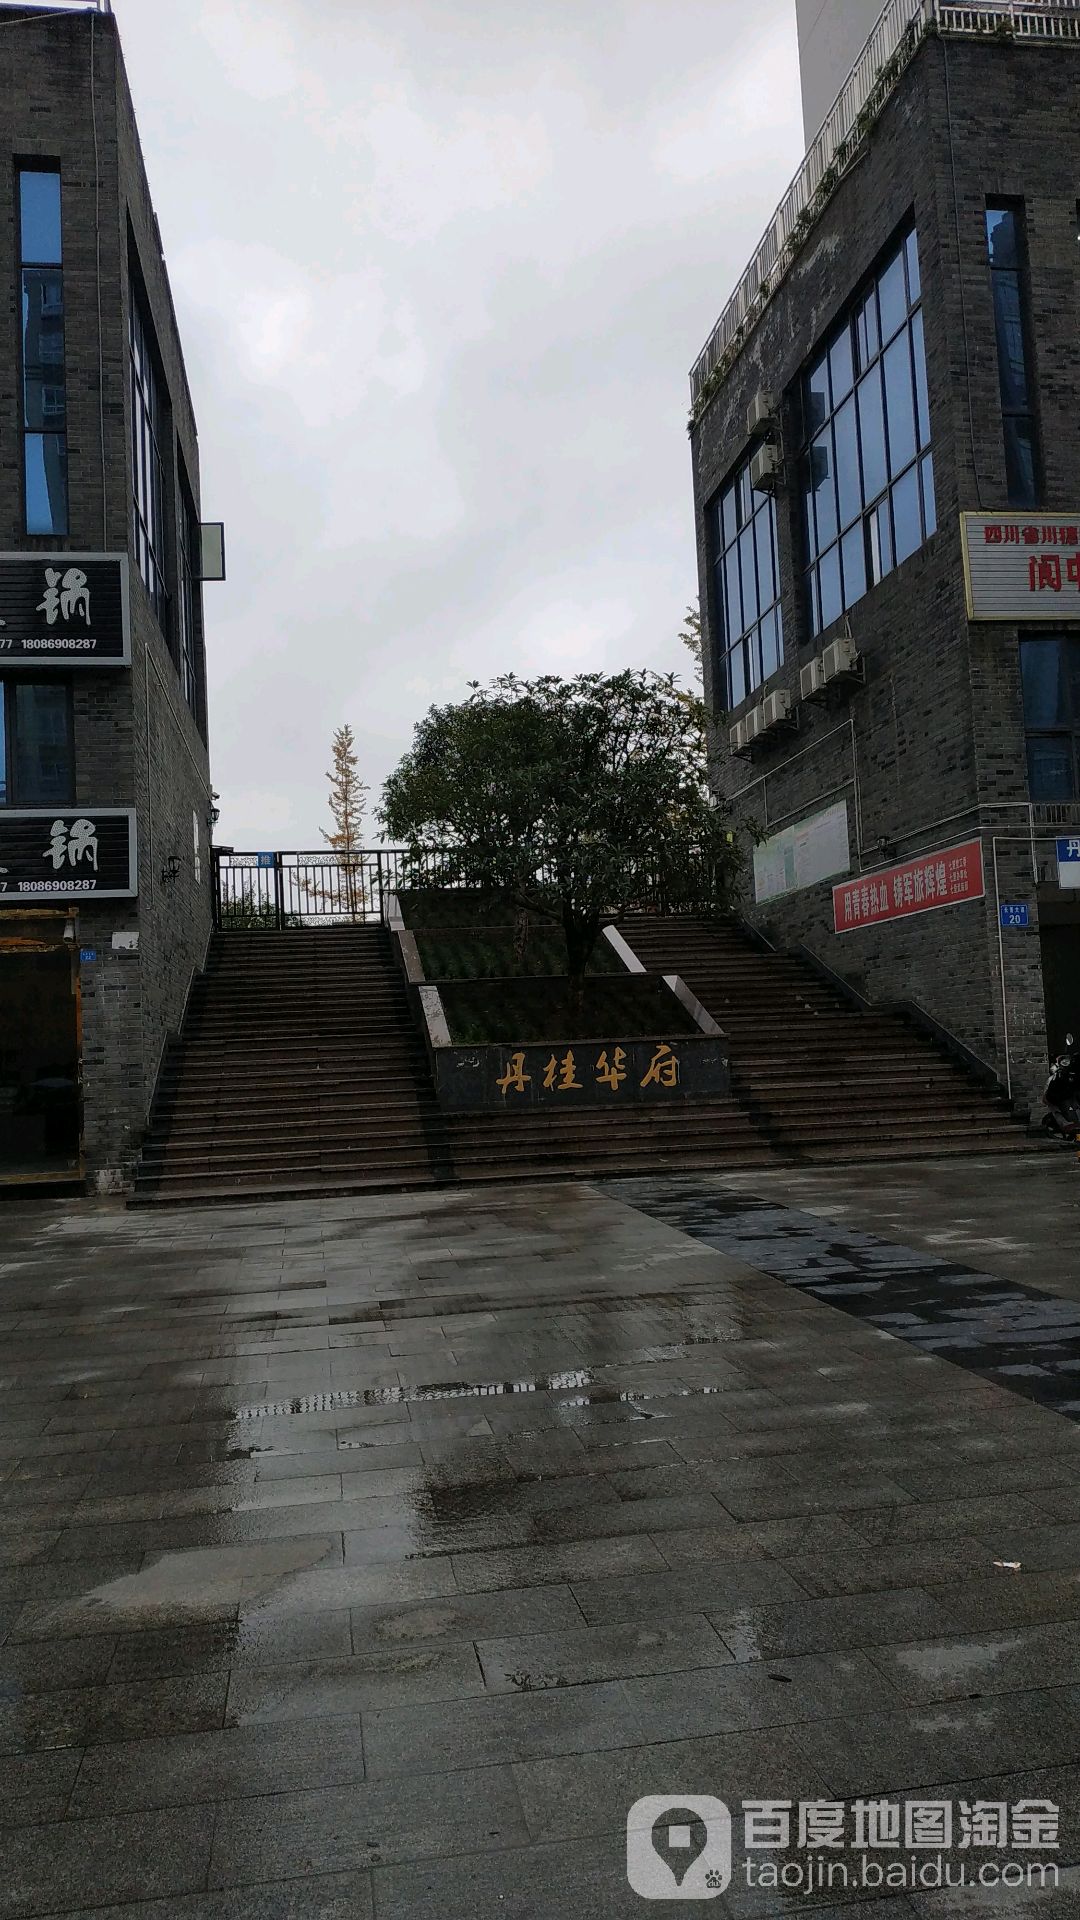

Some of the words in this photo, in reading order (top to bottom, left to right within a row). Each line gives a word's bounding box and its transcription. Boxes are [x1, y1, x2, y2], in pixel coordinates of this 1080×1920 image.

[21, 638, 97, 649] 18086908287
[18, 880, 97, 892] 18086908287
[844, 880, 889, 922] 用青春热血
[893, 860, 947, 908] 铸军旅辉煌
[1009, 914, 1021, 924] 20
[495, 1044, 680, 1095] 丹桂华府
